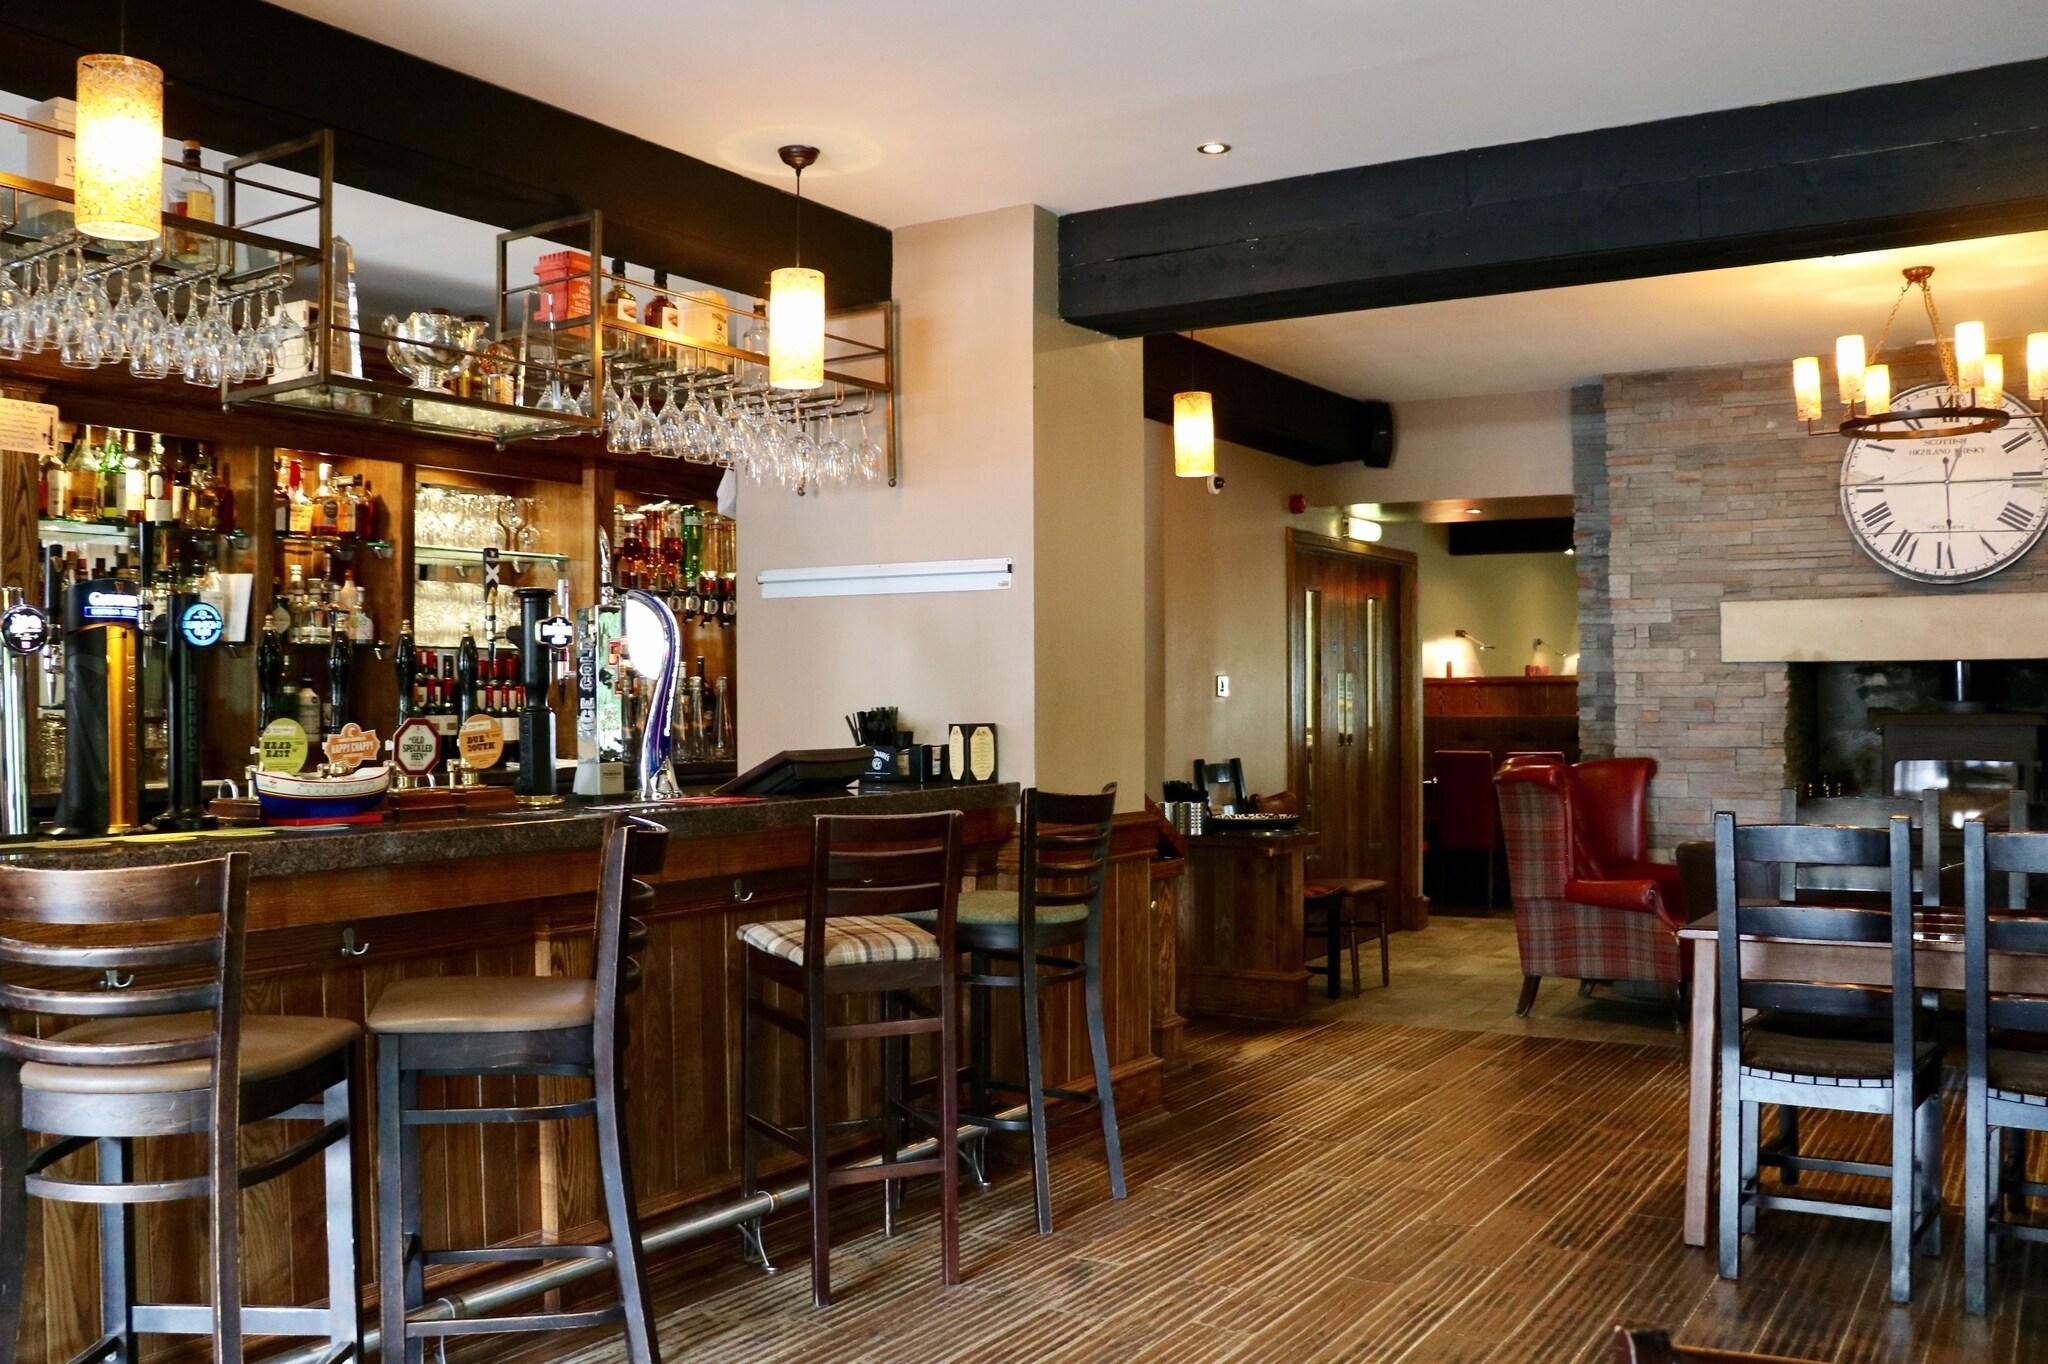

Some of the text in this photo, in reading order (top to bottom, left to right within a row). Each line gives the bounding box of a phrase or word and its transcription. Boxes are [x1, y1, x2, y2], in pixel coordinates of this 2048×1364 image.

[1923, 438, 1968, 446] SCOTTISH
[1908, 447, 1952, 457] HIGHLAND
[263, 741, 292, 750] HEAD
[352, 740, 374, 752] CHAPPY
[402, 743, 434, 753] SPECKLED
[467, 741, 496, 752] SOUTH
